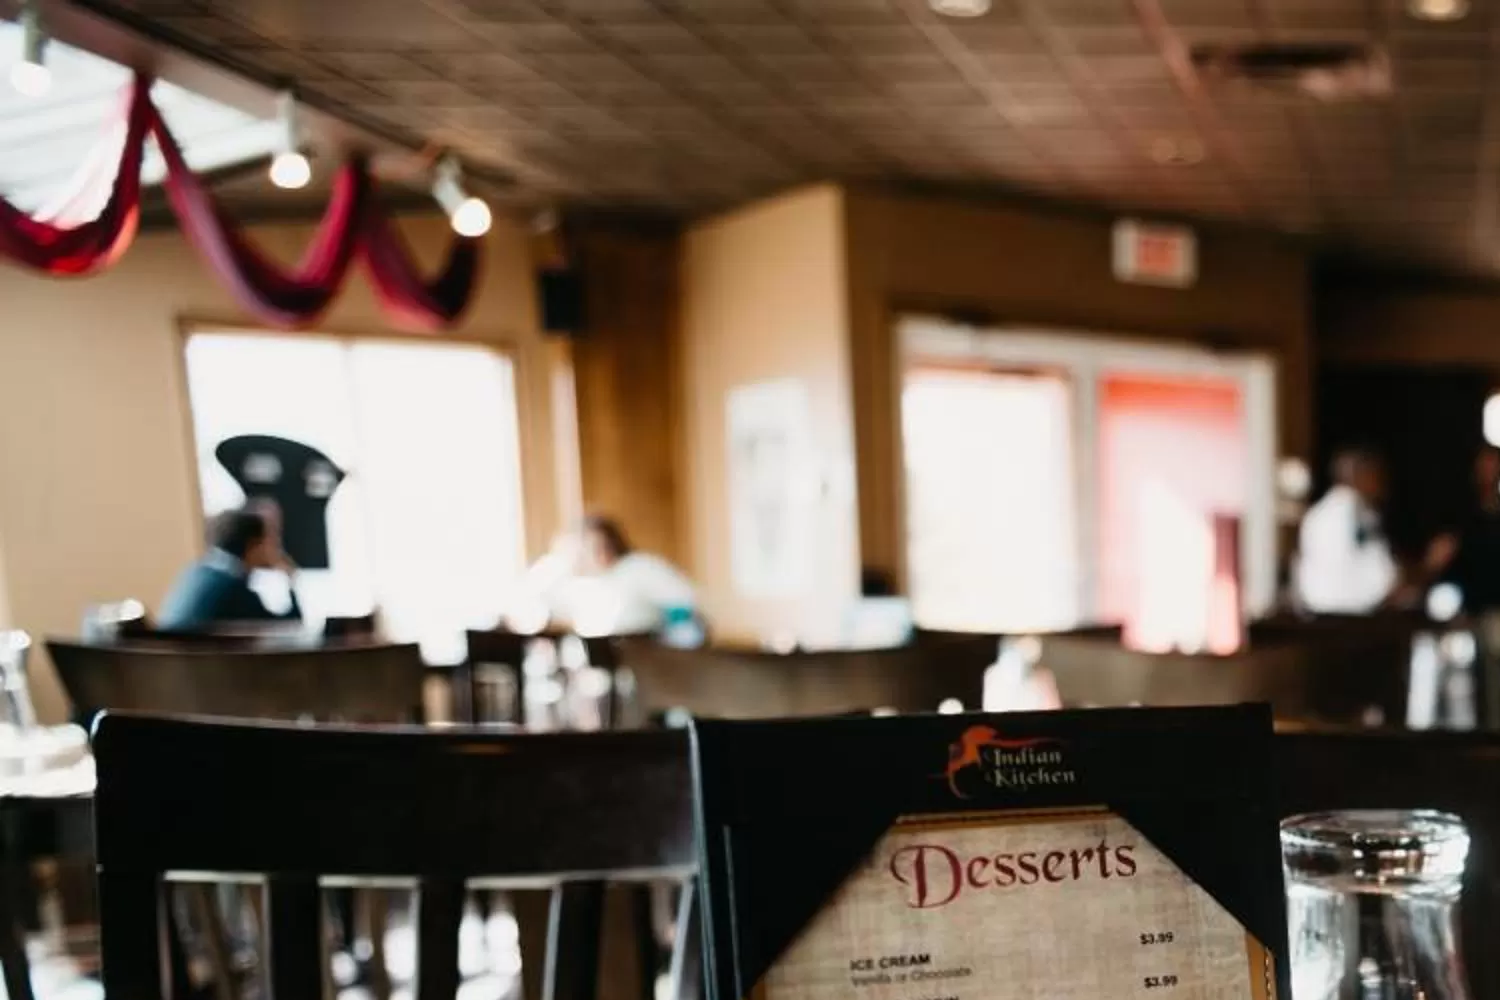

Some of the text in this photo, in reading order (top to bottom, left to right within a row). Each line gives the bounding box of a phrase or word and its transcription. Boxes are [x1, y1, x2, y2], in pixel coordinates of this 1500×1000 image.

[994, 748, 1062, 767] Indian
[994, 767, 1077, 789] Kitchen
[890, 839, 1137, 909] Desserts
[850, 932, 1174, 971] ICE CREAM $3.99
[911, 967, 972, 981] Chocolate
[1144, 975, 1178, 989] $3.99
